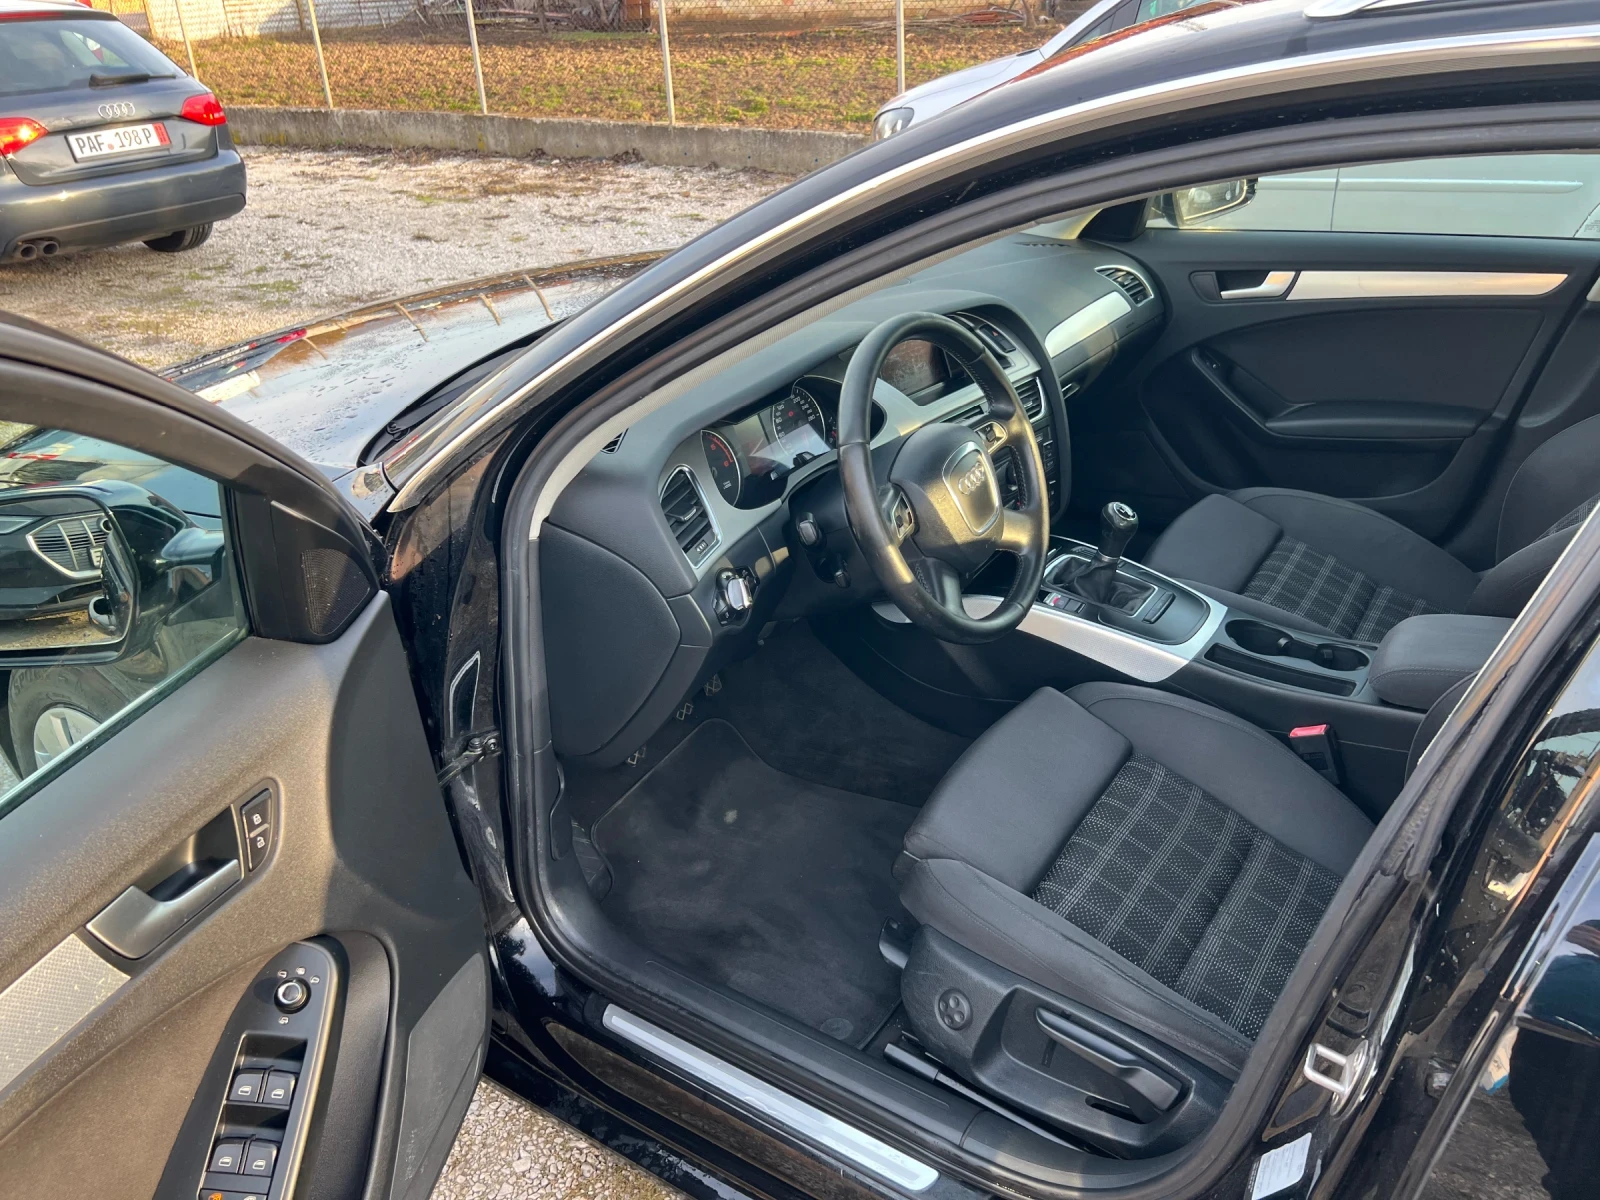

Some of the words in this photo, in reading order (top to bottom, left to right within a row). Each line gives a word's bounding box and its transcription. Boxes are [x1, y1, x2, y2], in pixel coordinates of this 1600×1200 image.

[75, 134, 104, 155] PAF
[114, 129, 142, 148] 198
[141, 127, 152, 144] P
